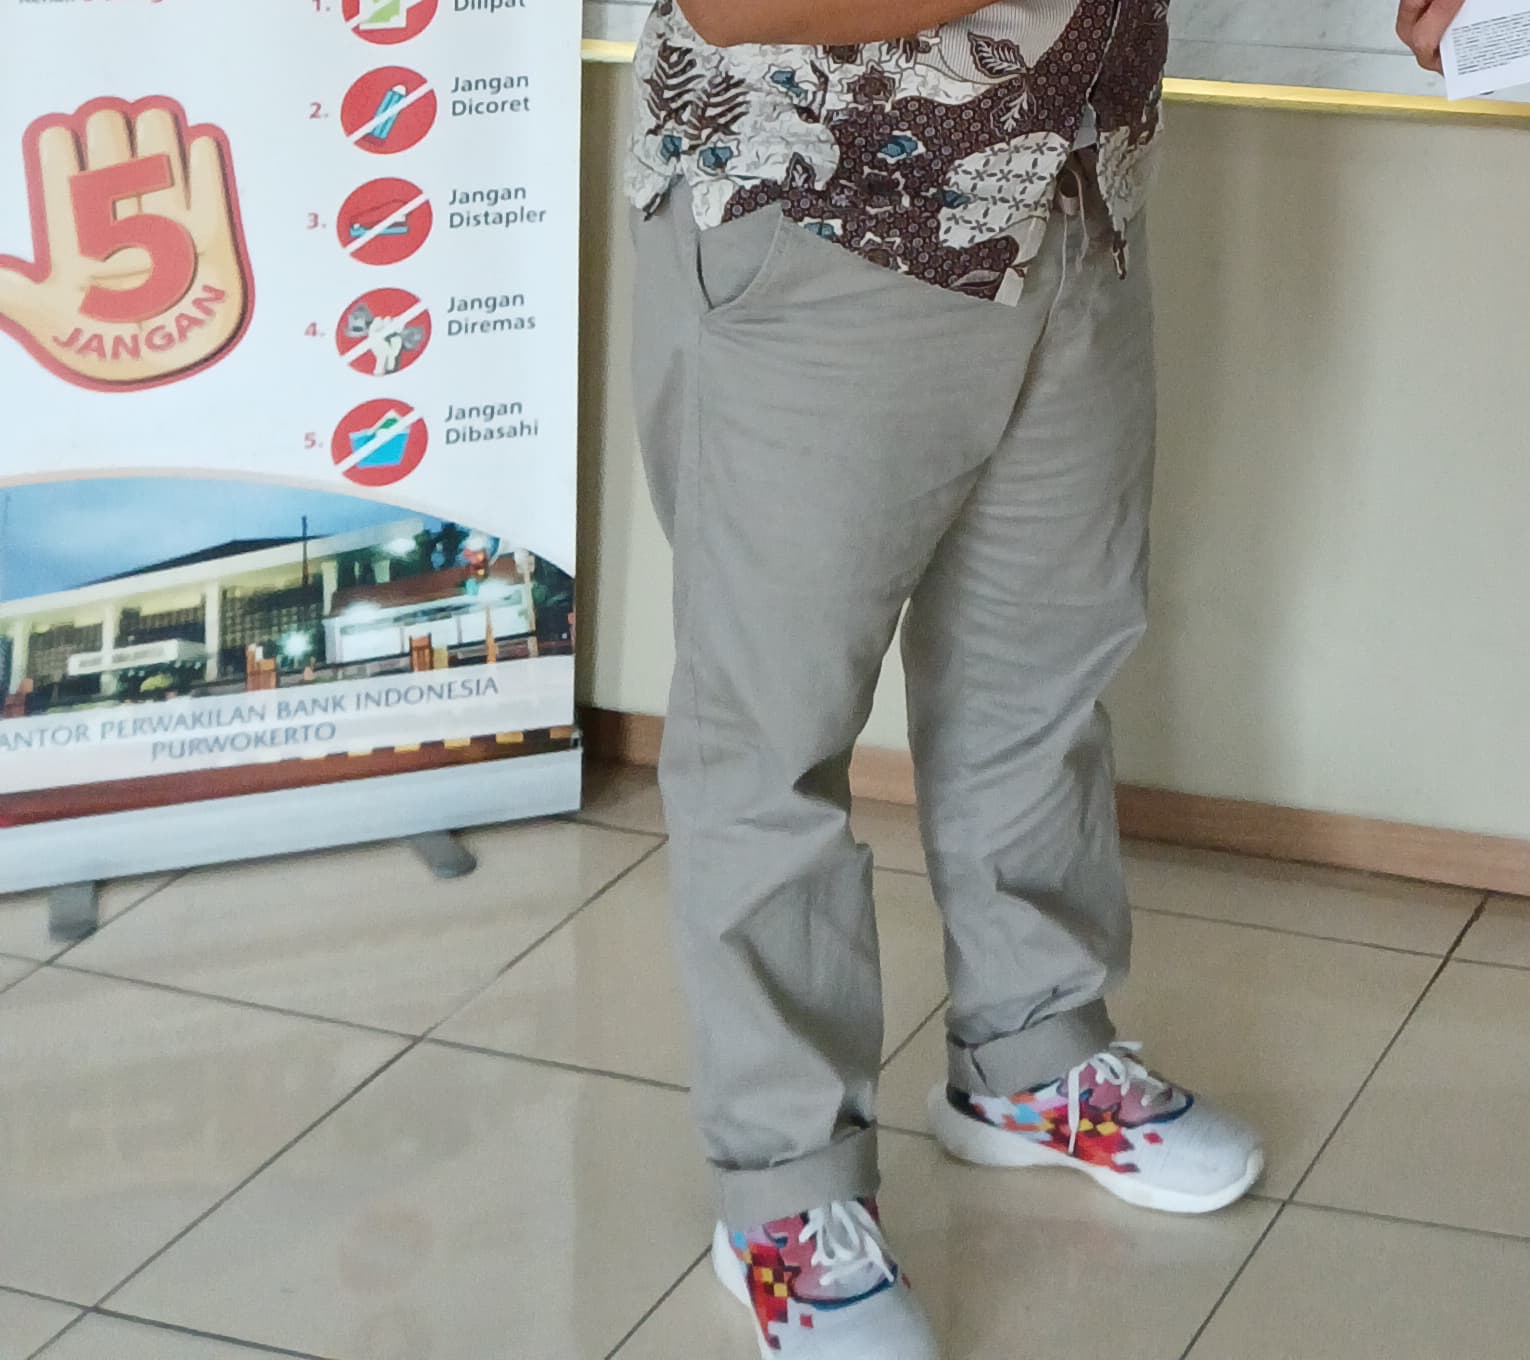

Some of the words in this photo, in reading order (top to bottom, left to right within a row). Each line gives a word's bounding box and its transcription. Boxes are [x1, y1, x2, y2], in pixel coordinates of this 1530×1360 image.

[450, 73, 531, 96] Jangan
[451, 95, 532, 117] Dicoret
[448, 185, 528, 208] Jangan
[448, 206, 548, 230] Distapler
[68, 152, 200, 324] 5
[446, 292, 526, 315] Jangan
[52, 283, 228, 361] JANGAN
[446, 313, 537, 337] Diremas
[444, 399, 524, 423] Jangan
[444, 420, 540, 445] Dibasahi
[100, 704, 267, 741] PERWAKILAN
[276, 695, 347, 719] BANK
[355, 676, 499, 713] INDONESIA
[151, 722, 337, 762] PURWOKERTO
